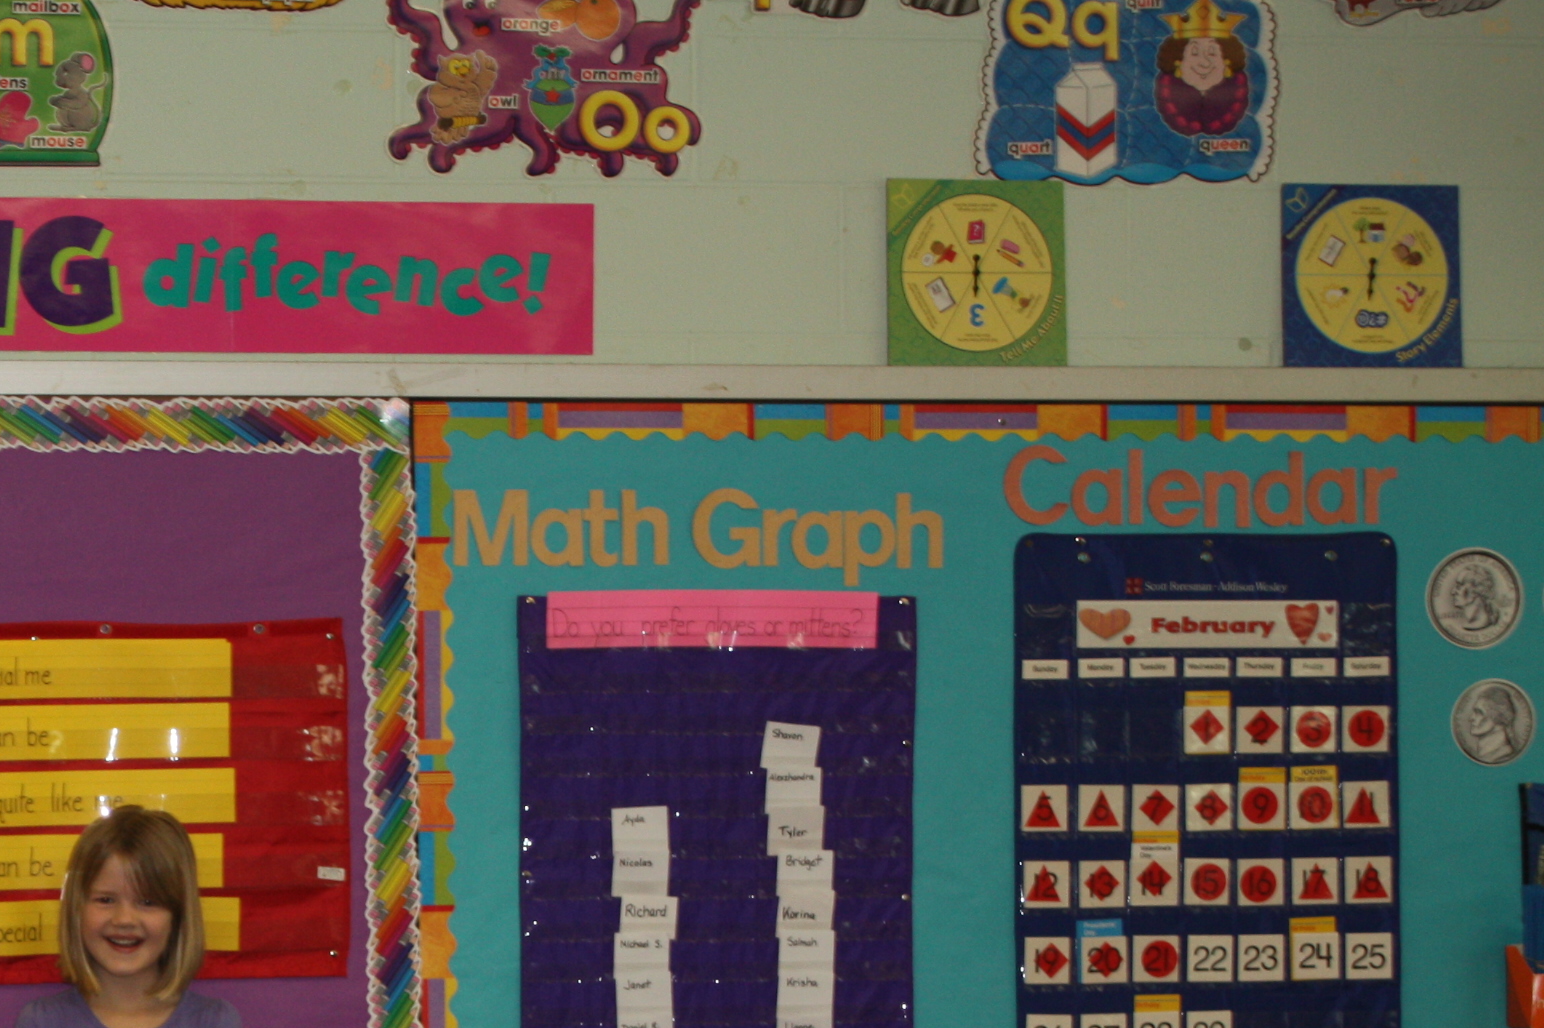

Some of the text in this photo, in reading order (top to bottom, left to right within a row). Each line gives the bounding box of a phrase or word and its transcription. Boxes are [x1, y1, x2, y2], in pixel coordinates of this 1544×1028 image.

[13, 0, 80, 14] mailbox
[502, 18, 560, 34] orange
[1007, 0, 1120, 61] Qq
[581, 68, 658, 82] ornament
[489, 94, 517, 108] owl
[578, 90, 690, 153] Oo
[31, 135, 85, 147] mouse
[1008, 140, 1051, 157] quart
[1200, 138, 1249, 155] queen
[143, 232, 550, 316] difference!
[1396, 343, 1427, 362] Story
[1422, 298, 1458, 349] Elements
[1003, 445, 1398, 528] Calendar
[452, 488, 944, 587] Math Graph
[1145, 581, 1167, 591] Scott
[1218, 581, 1255, 591] Addison
[551, 606, 864, 647] Do you prefer gloves or mittens?
[1150, 616, 1276, 639] February
[24, 669, 52, 686] me
[27, 717, 50, 747] be
[1251, 718, 1268, 743] 2
[51, 782, 83, 814] like
[1200, 792, 1270, 821] 8 9
[778, 825, 808, 839] Tyler
[29, 846, 55, 877] be
[619, 858, 653, 867] Nicolas
[785, 855, 823, 871] Bridget
[1356, 867, 1379, 893] 18
[625, 903, 667, 918] Richard
[1034, 942, 1387, 975] 19 20 22 23 24 25
